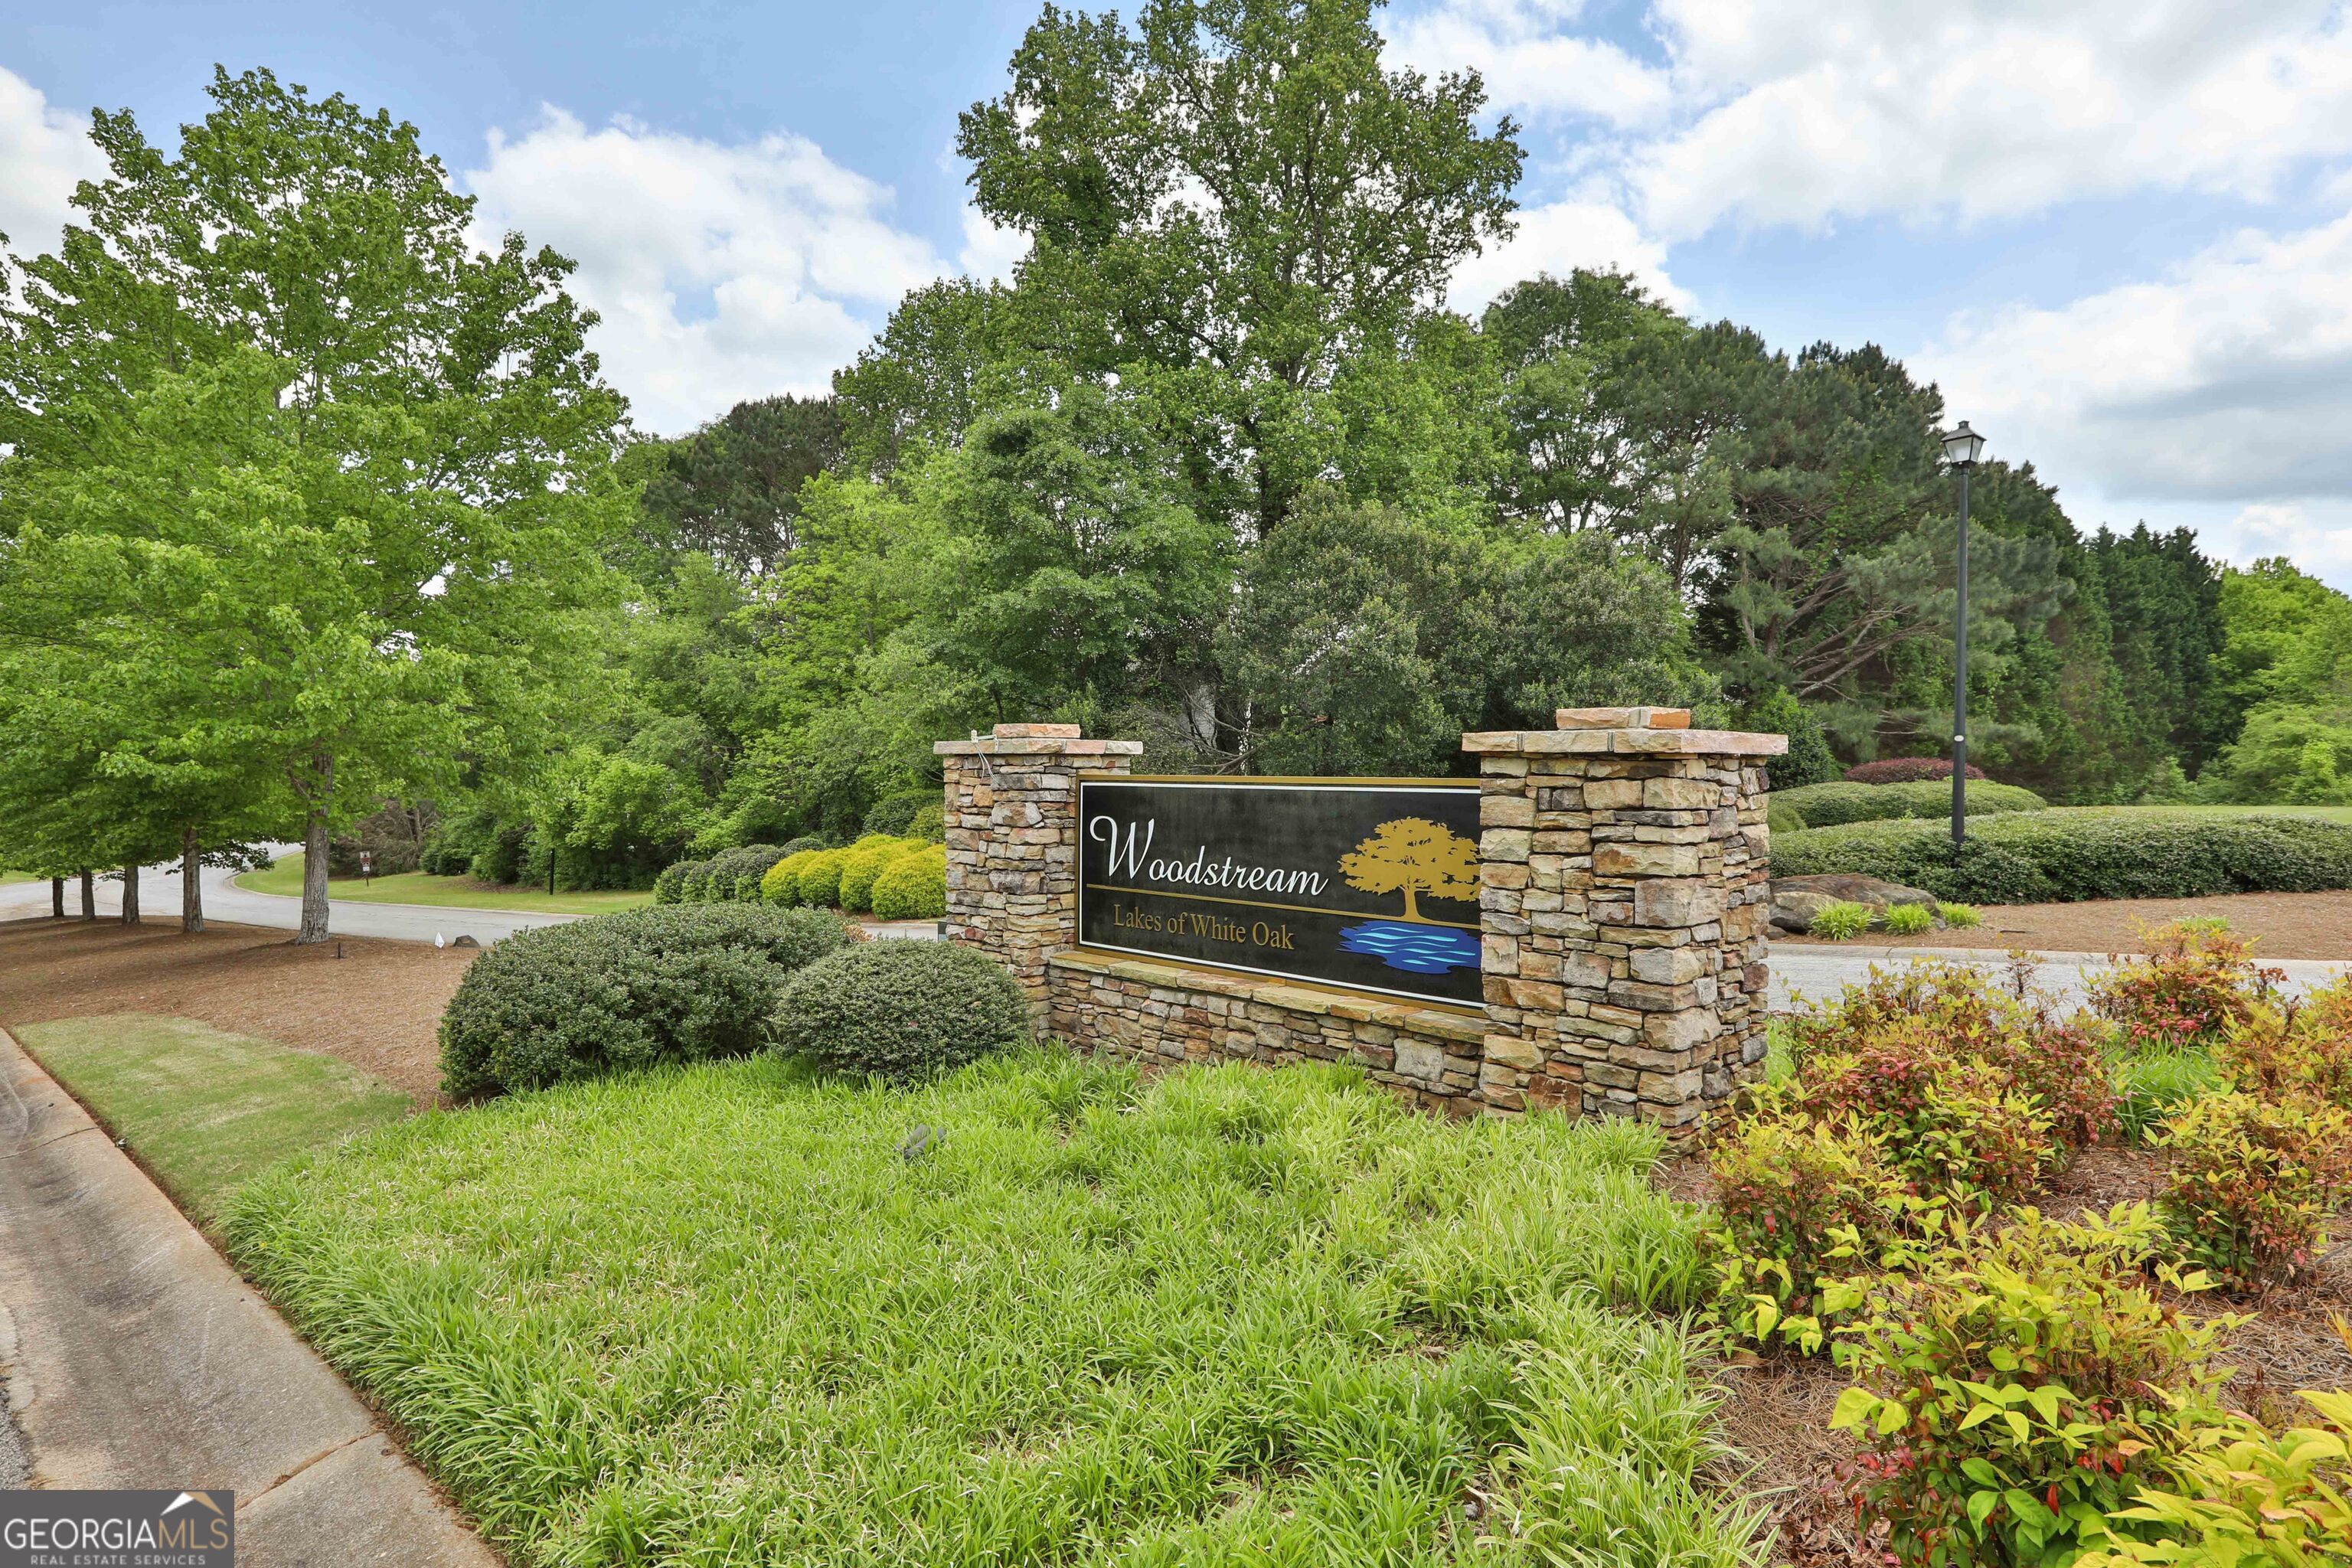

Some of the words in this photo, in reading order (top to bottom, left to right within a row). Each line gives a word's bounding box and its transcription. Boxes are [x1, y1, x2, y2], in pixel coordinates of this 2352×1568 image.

[1089, 815, 1328, 896] Woodstream
[1113, 904, 1161, 932] Lakes
[1167, 912, 1187, 936] of
[1190, 913, 1246, 943] White
[1252, 921, 1295, 950] Oak
